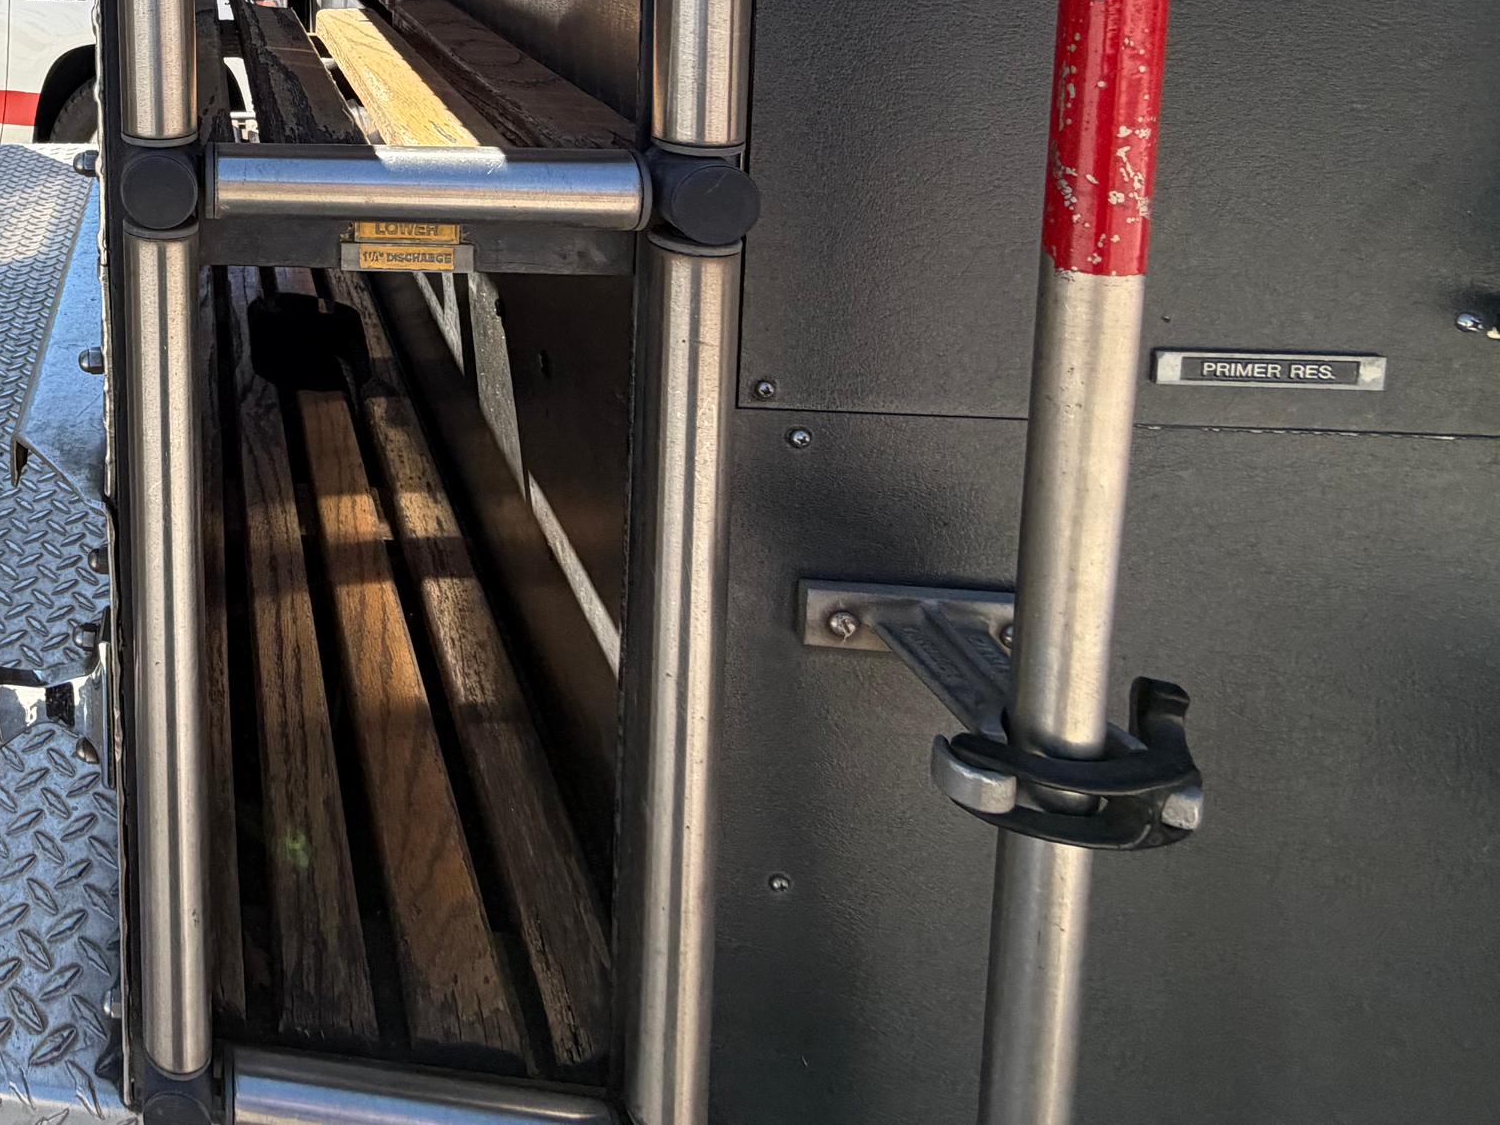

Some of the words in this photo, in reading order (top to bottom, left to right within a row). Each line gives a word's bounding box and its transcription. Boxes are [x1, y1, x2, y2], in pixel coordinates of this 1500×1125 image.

[374, 221, 439, 236] LOWER
[386, 251, 453, 265] DISCHARGE
[1202, 362, 1281, 379] PRIMER
[1290, 364, 1336, 380] RES.
